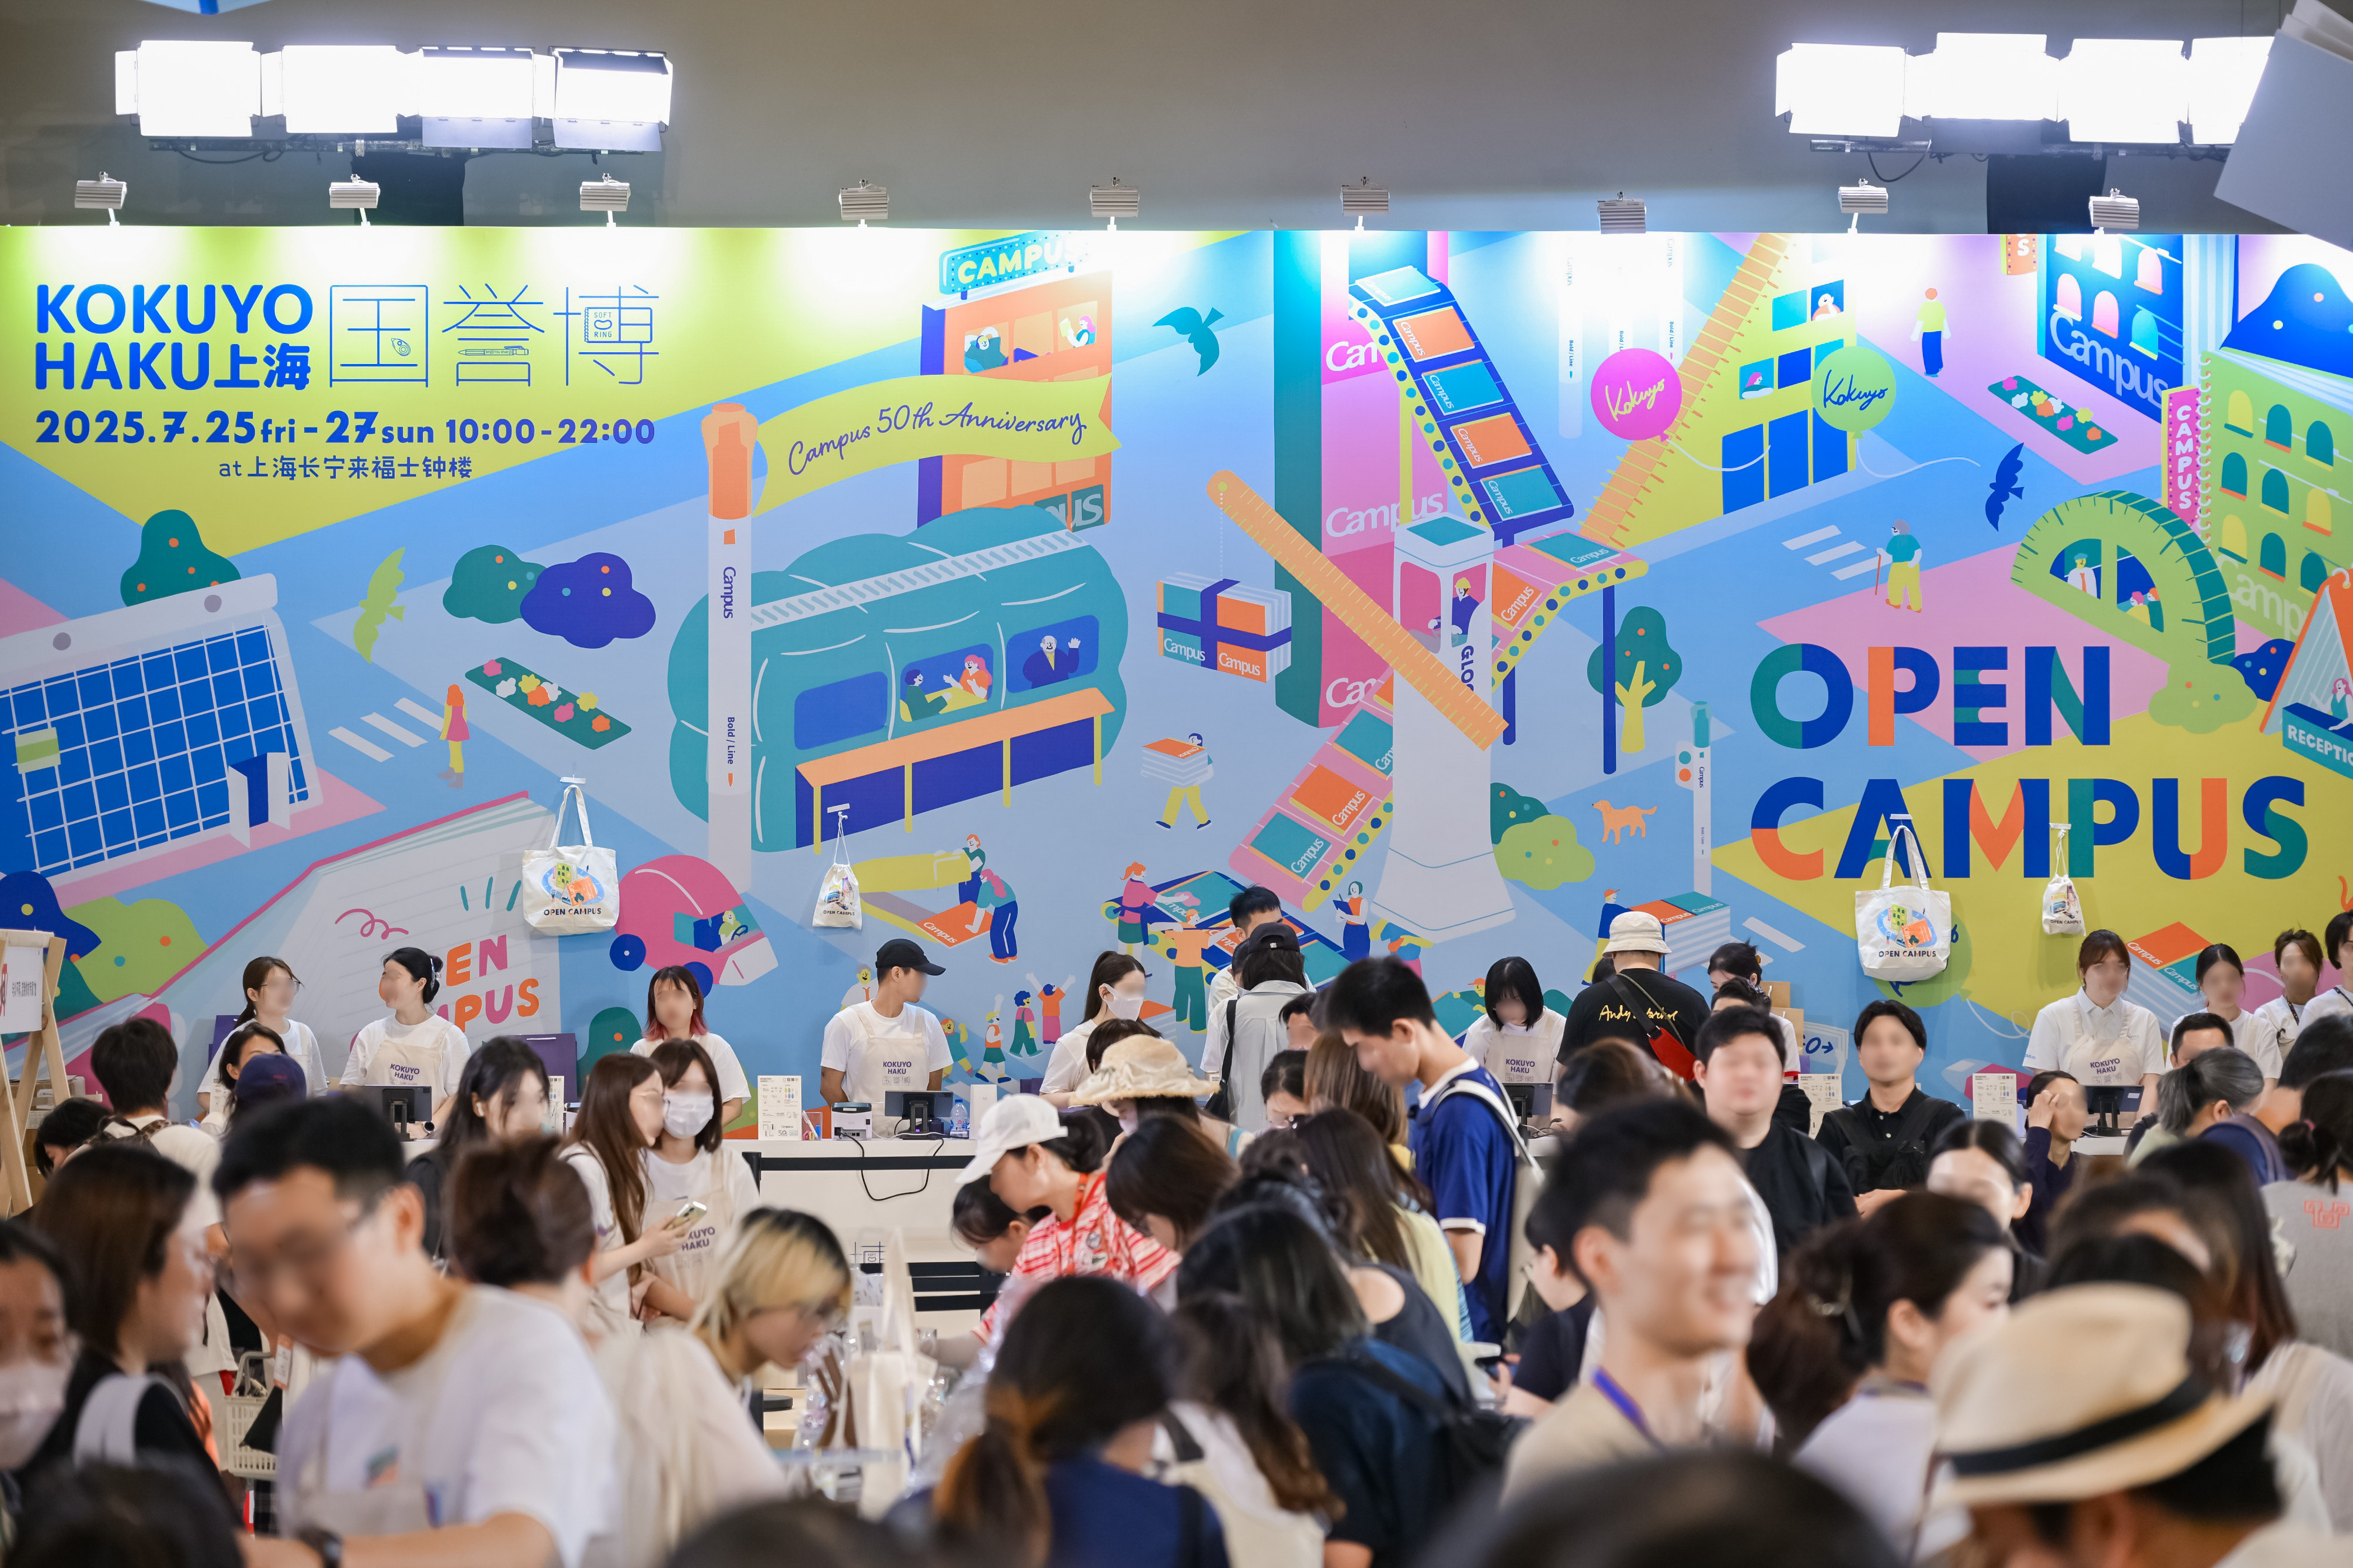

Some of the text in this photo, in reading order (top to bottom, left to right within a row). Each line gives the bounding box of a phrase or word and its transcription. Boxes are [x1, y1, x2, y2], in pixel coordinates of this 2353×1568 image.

[958, 237, 1080, 283] CAMPU
[35, 284, 313, 334] KOKUYO
[329, 283, 659, 386] 国誉博
[1399, 321, 1426, 356] Campus
[2050, 312, 2168, 407] Campus
[1429, 375, 1454, 409] Campus
[1605, 378, 1665, 422] Kokuyo
[1823, 369, 1888, 411] Kokuyo
[788, 402, 1087, 475] Campus 50th Anniversary
[1458, 428, 1483, 462] Campus
[247, 456, 472, 480] 上海长宁来福士钟楼
[2175, 405, 2193, 509] CAMPUS
[1488, 480, 1513, 515] Campus
[1325, 493, 1444, 538] Campus
[1570, 549, 1609, 563] Campus
[723, 566, 736, 619] Campus
[1501, 586, 1534, 621] Campus
[2215, 553, 2309, 642] Camp
[1164, 638, 1206, 661] Campus
[1219, 652, 1261, 676] Campus
[1750, 643, 2111, 749] OPEN
[727, 716, 735, 738] Bold
[727, 745, 735, 765] Line
[1332, 790, 1366, 826] Campus
[1750, 776, 2308, 880] CAMPUS
[1291, 838, 1324, 873] Campus
[1660, 912, 1692, 923] Campus
[1692, 902, 1724, 913] Campus
[924, 922, 958, 943] Campus
[2127, 942, 2163, 965] Campus
[2164, 968, 2199, 990] Campus
[1599, 1005, 1631, 1022] Andy
[390, 1063, 420, 1075] KOKUYO
[394, 1072, 414, 1081] HAKU
[1506, 1059, 1535, 1067] KOKUYO
[2090, 1058, 2120, 1068] KOKUYO
[2097, 1066, 2116, 1075] HAKU
[682, 1238, 709, 1251] HAKU
